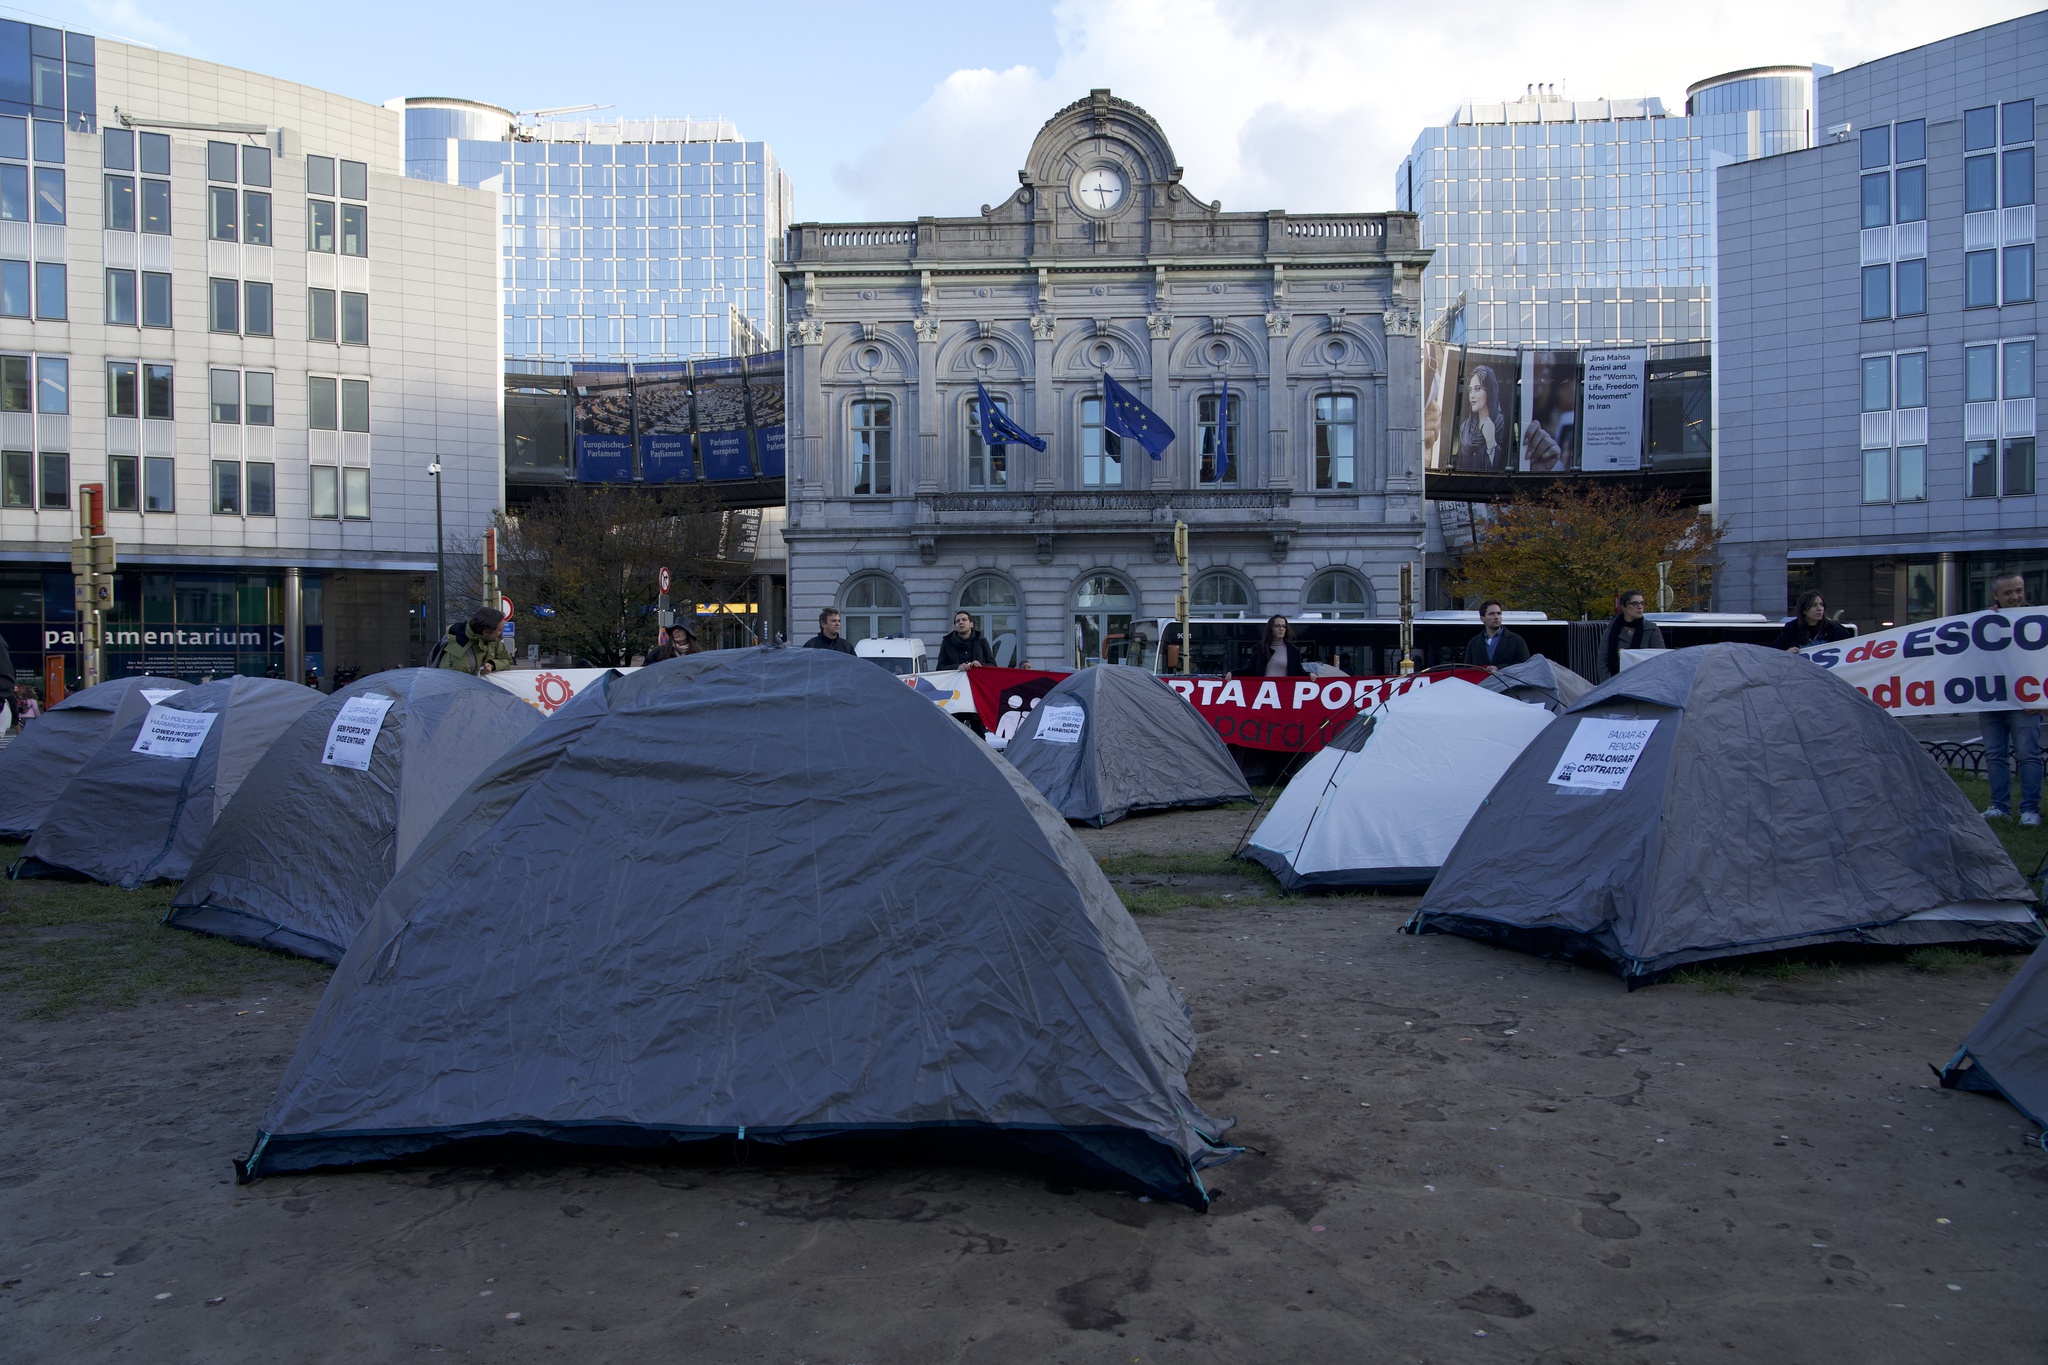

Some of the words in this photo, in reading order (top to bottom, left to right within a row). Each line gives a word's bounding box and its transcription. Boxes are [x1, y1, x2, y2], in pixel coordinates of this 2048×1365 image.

[583, 441, 624, 449] Europäisches
[710, 438, 739, 446] Parlement
[713, 447, 739, 456] européen
[45, 628, 261, 648] paramentarium
[1845, 640, 1898, 663] de
[1902, 614, 2048, 658] ESCO
[1251, 681, 1282, 710] A
[1292, 676, 1432, 710] PORTA
[1944, 675, 2007, 704] ou
[2015, 676, 2048, 702] c
[150, 718, 180, 728] HARMING
[170, 716, 196, 724] POLICIES
[152, 727, 175, 736] LOWER
[346, 725, 360, 734] PORTA
[1214, 714, 1304, 748] para
[336, 735, 347, 743] ONDE
[1608, 730, 1636, 739] BAIXAR
[1636, 730, 1647, 739] AS
[1608, 742, 1641, 751] RENDAS
[1584, 753, 1634, 763] PROLONGAR
[1577, 765, 1629, 775] CONTRATOS!
